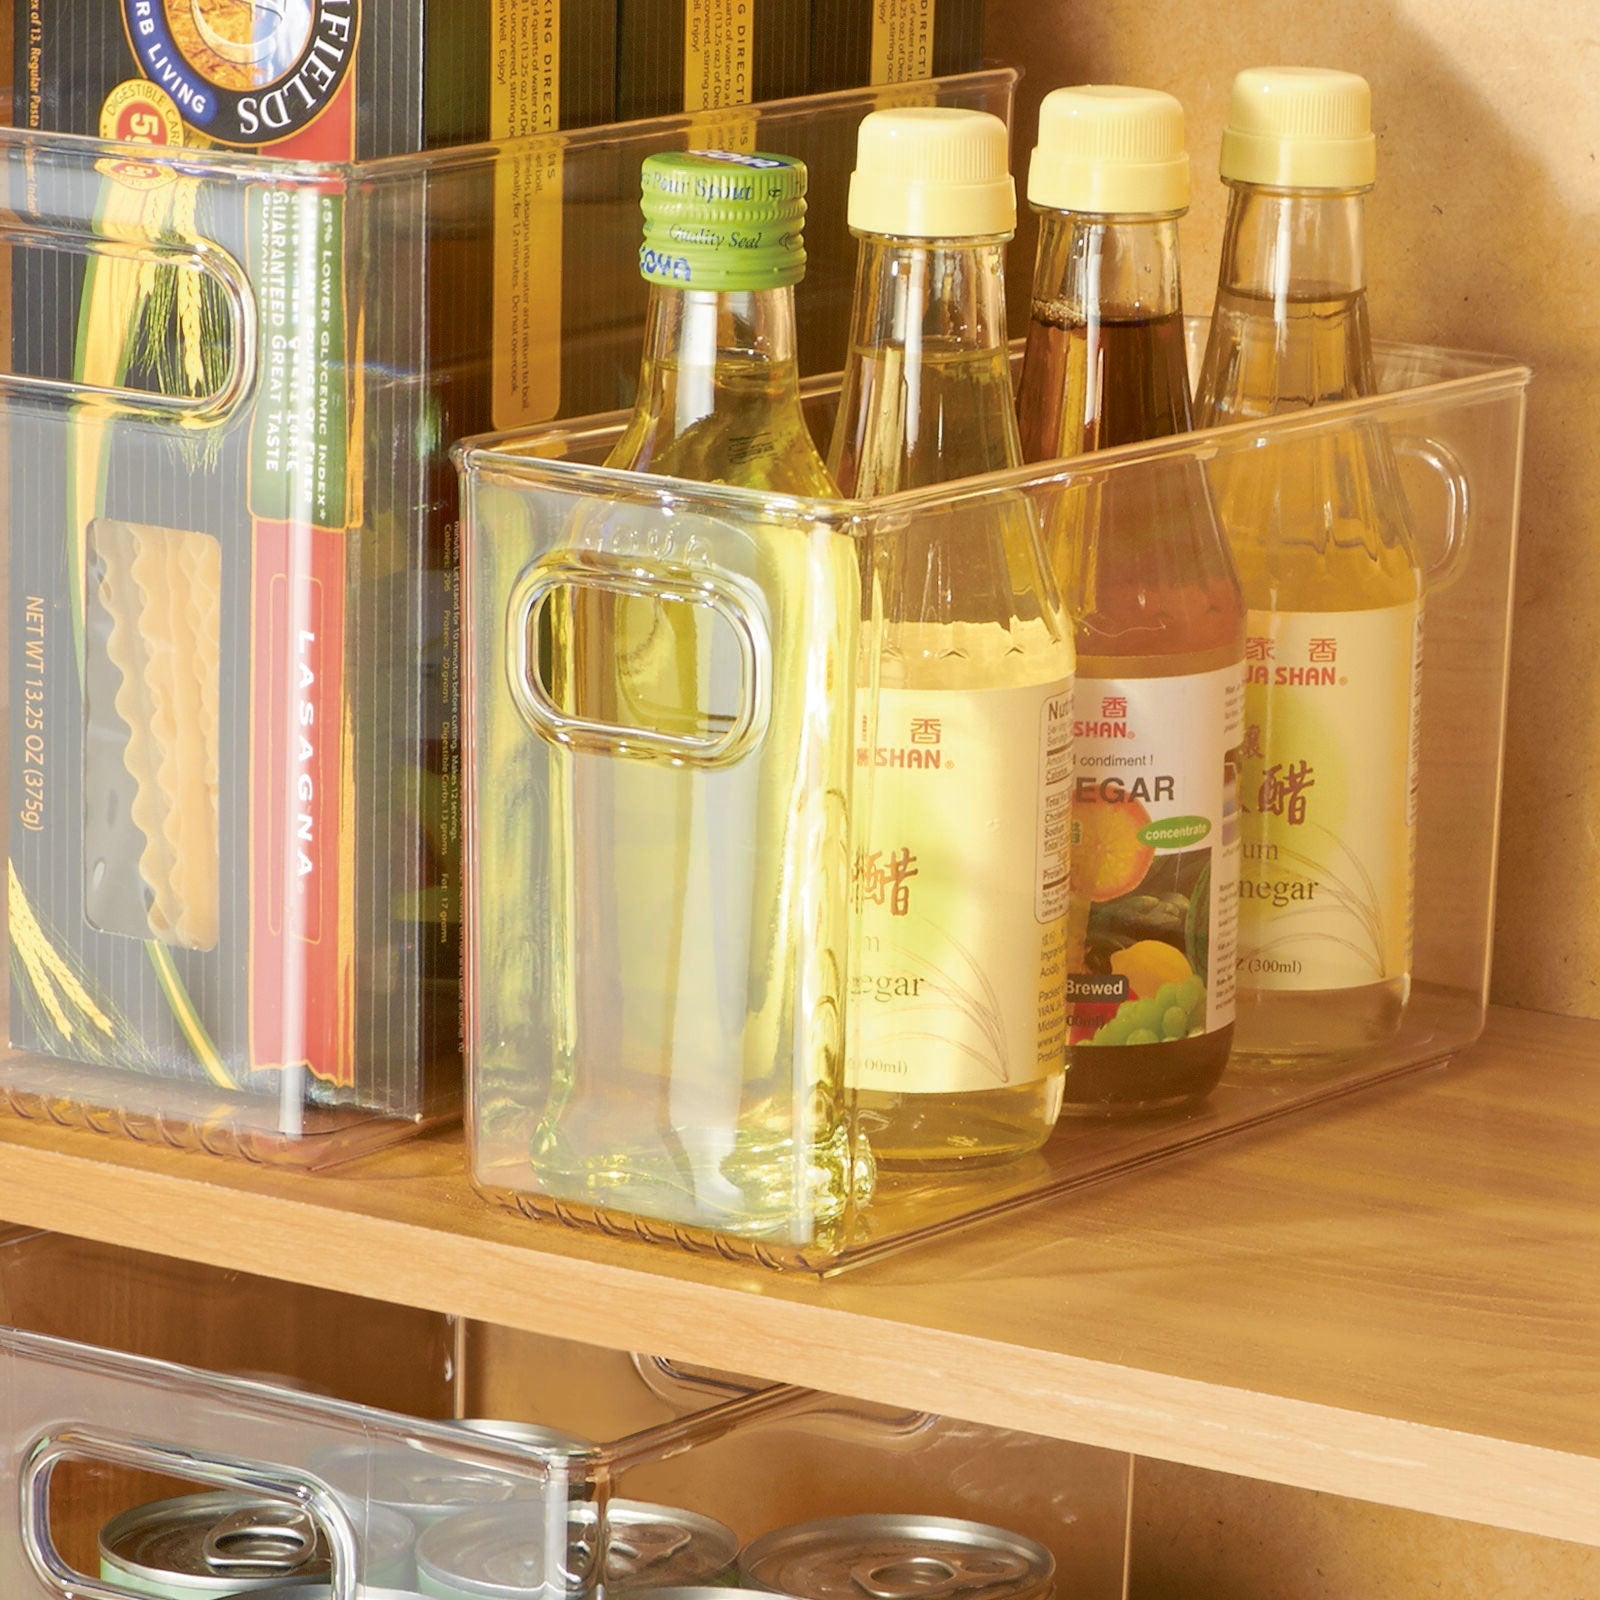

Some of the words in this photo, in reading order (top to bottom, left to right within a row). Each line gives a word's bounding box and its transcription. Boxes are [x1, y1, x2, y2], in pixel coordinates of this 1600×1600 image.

[30, 11, 41, 24] of
[909, 3, 916, 14] of
[521, 16, 529, 38] box
[530, 19, 539, 56] quarts
[691, 17, 700, 52] Enjoy!
[713, 11, 722, 46] (13.25
[725, 29, 733, 41] of
[886, 21, 896, 61] stirring
[908, 16, 916, 48] water
[509, 13, 518, 79] uncovered,
[519, 42, 529, 77] (13.25
[899, 43, 905, 55] of
[908, 50, 915, 63] to
[28, 48, 42, 93] Regular
[148, 43, 207, 114] LIVING
[497, 50, 507, 85] Enjoy!
[531, 60, 540, 73] of
[702, 49, 711, 89] stirring
[714, 71, 721, 84] of
[105, 84, 167, 116] DIGESTIBLE
[531, 75, 539, 109] water
[724, 79, 732, 91] to
[29, 95, 41, 127] Pasta
[507, 81, 517, 123] stirring
[520, 104, 529, 117] of
[531, 111, 539, 123] to
[694, 177, 751, 203] Spout
[322, 198, 333, 243] 65%
[729, 232, 761, 248] Seal
[270, 191, 290, 327] GUARANTEED
[321, 250, 332, 323] LOWER
[270, 334, 287, 403] GREAT
[318, 331, 330, 435] GLYCEMIC
[265, 412, 282, 472] TASTE
[25, 595, 45, 637] NET
[25, 640, 45, 674] WT
[1275, 667, 1336, 686] SHAN
[25, 679, 44, 729] 13.25
[1101, 696, 1127, 718] 香
[911, 718, 941, 744] 香
[1073, 721, 1127, 739] SHAN
[25, 734, 44, 765] OZ
[297, 629, 315, 877] LASAGNA
[875, 748, 941, 769] SHAN
[1079, 754, 1146, 767] condiment
[20, 768, 44, 830] (375g)
[1076, 775, 1174, 804] EGAR
[1145, 822, 1207, 841] concentrate
[1248, 959, 1302, 973] (300ml)
[1066, 980, 1123, 995] Brewed
